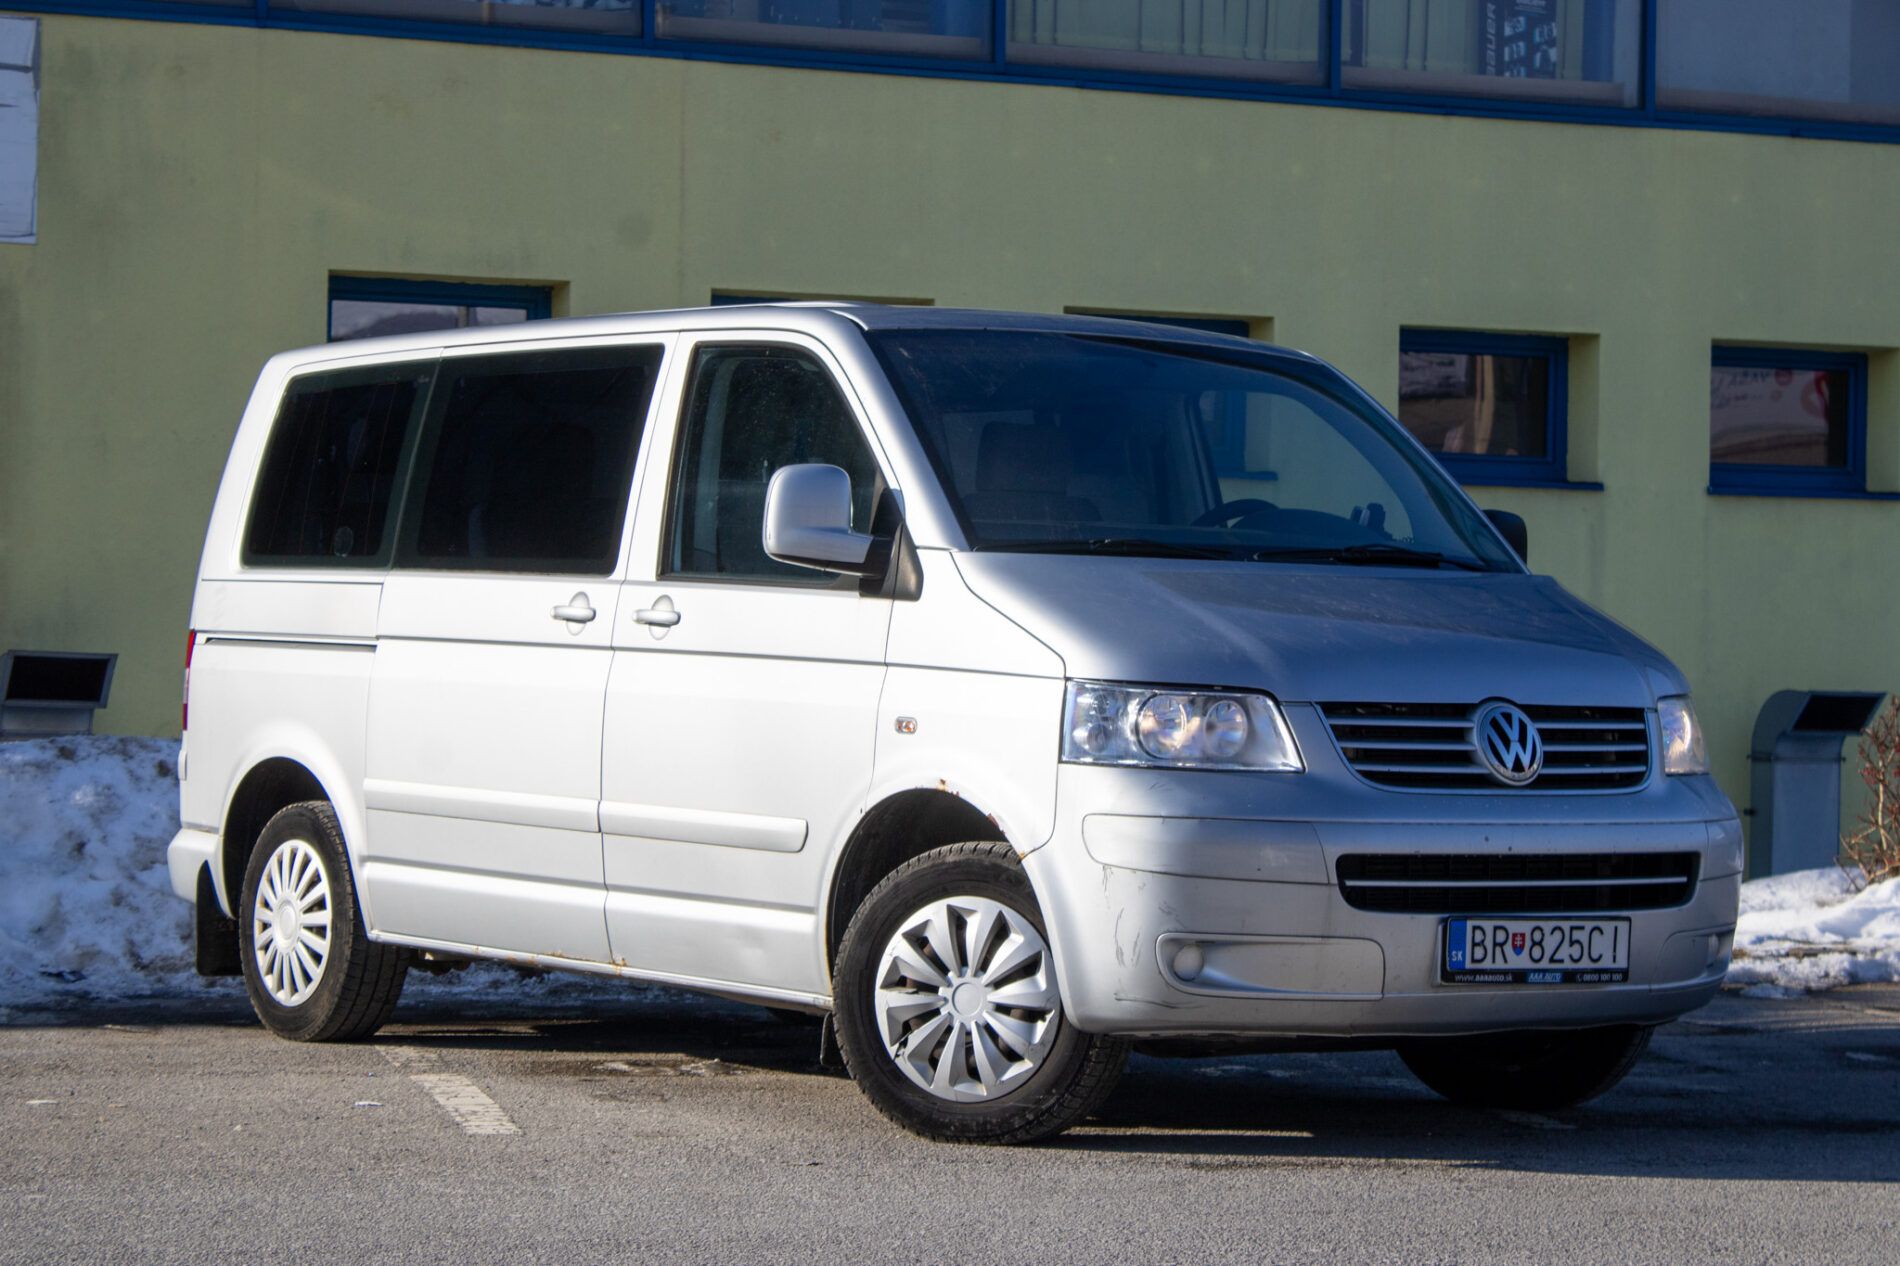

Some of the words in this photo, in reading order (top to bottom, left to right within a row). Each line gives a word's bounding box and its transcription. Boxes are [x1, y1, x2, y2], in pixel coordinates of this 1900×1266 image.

[1451, 951, 1463, 962] SK
[1470, 925, 1509, 964] BR
[1528, 925, 1618, 964] 825CI
